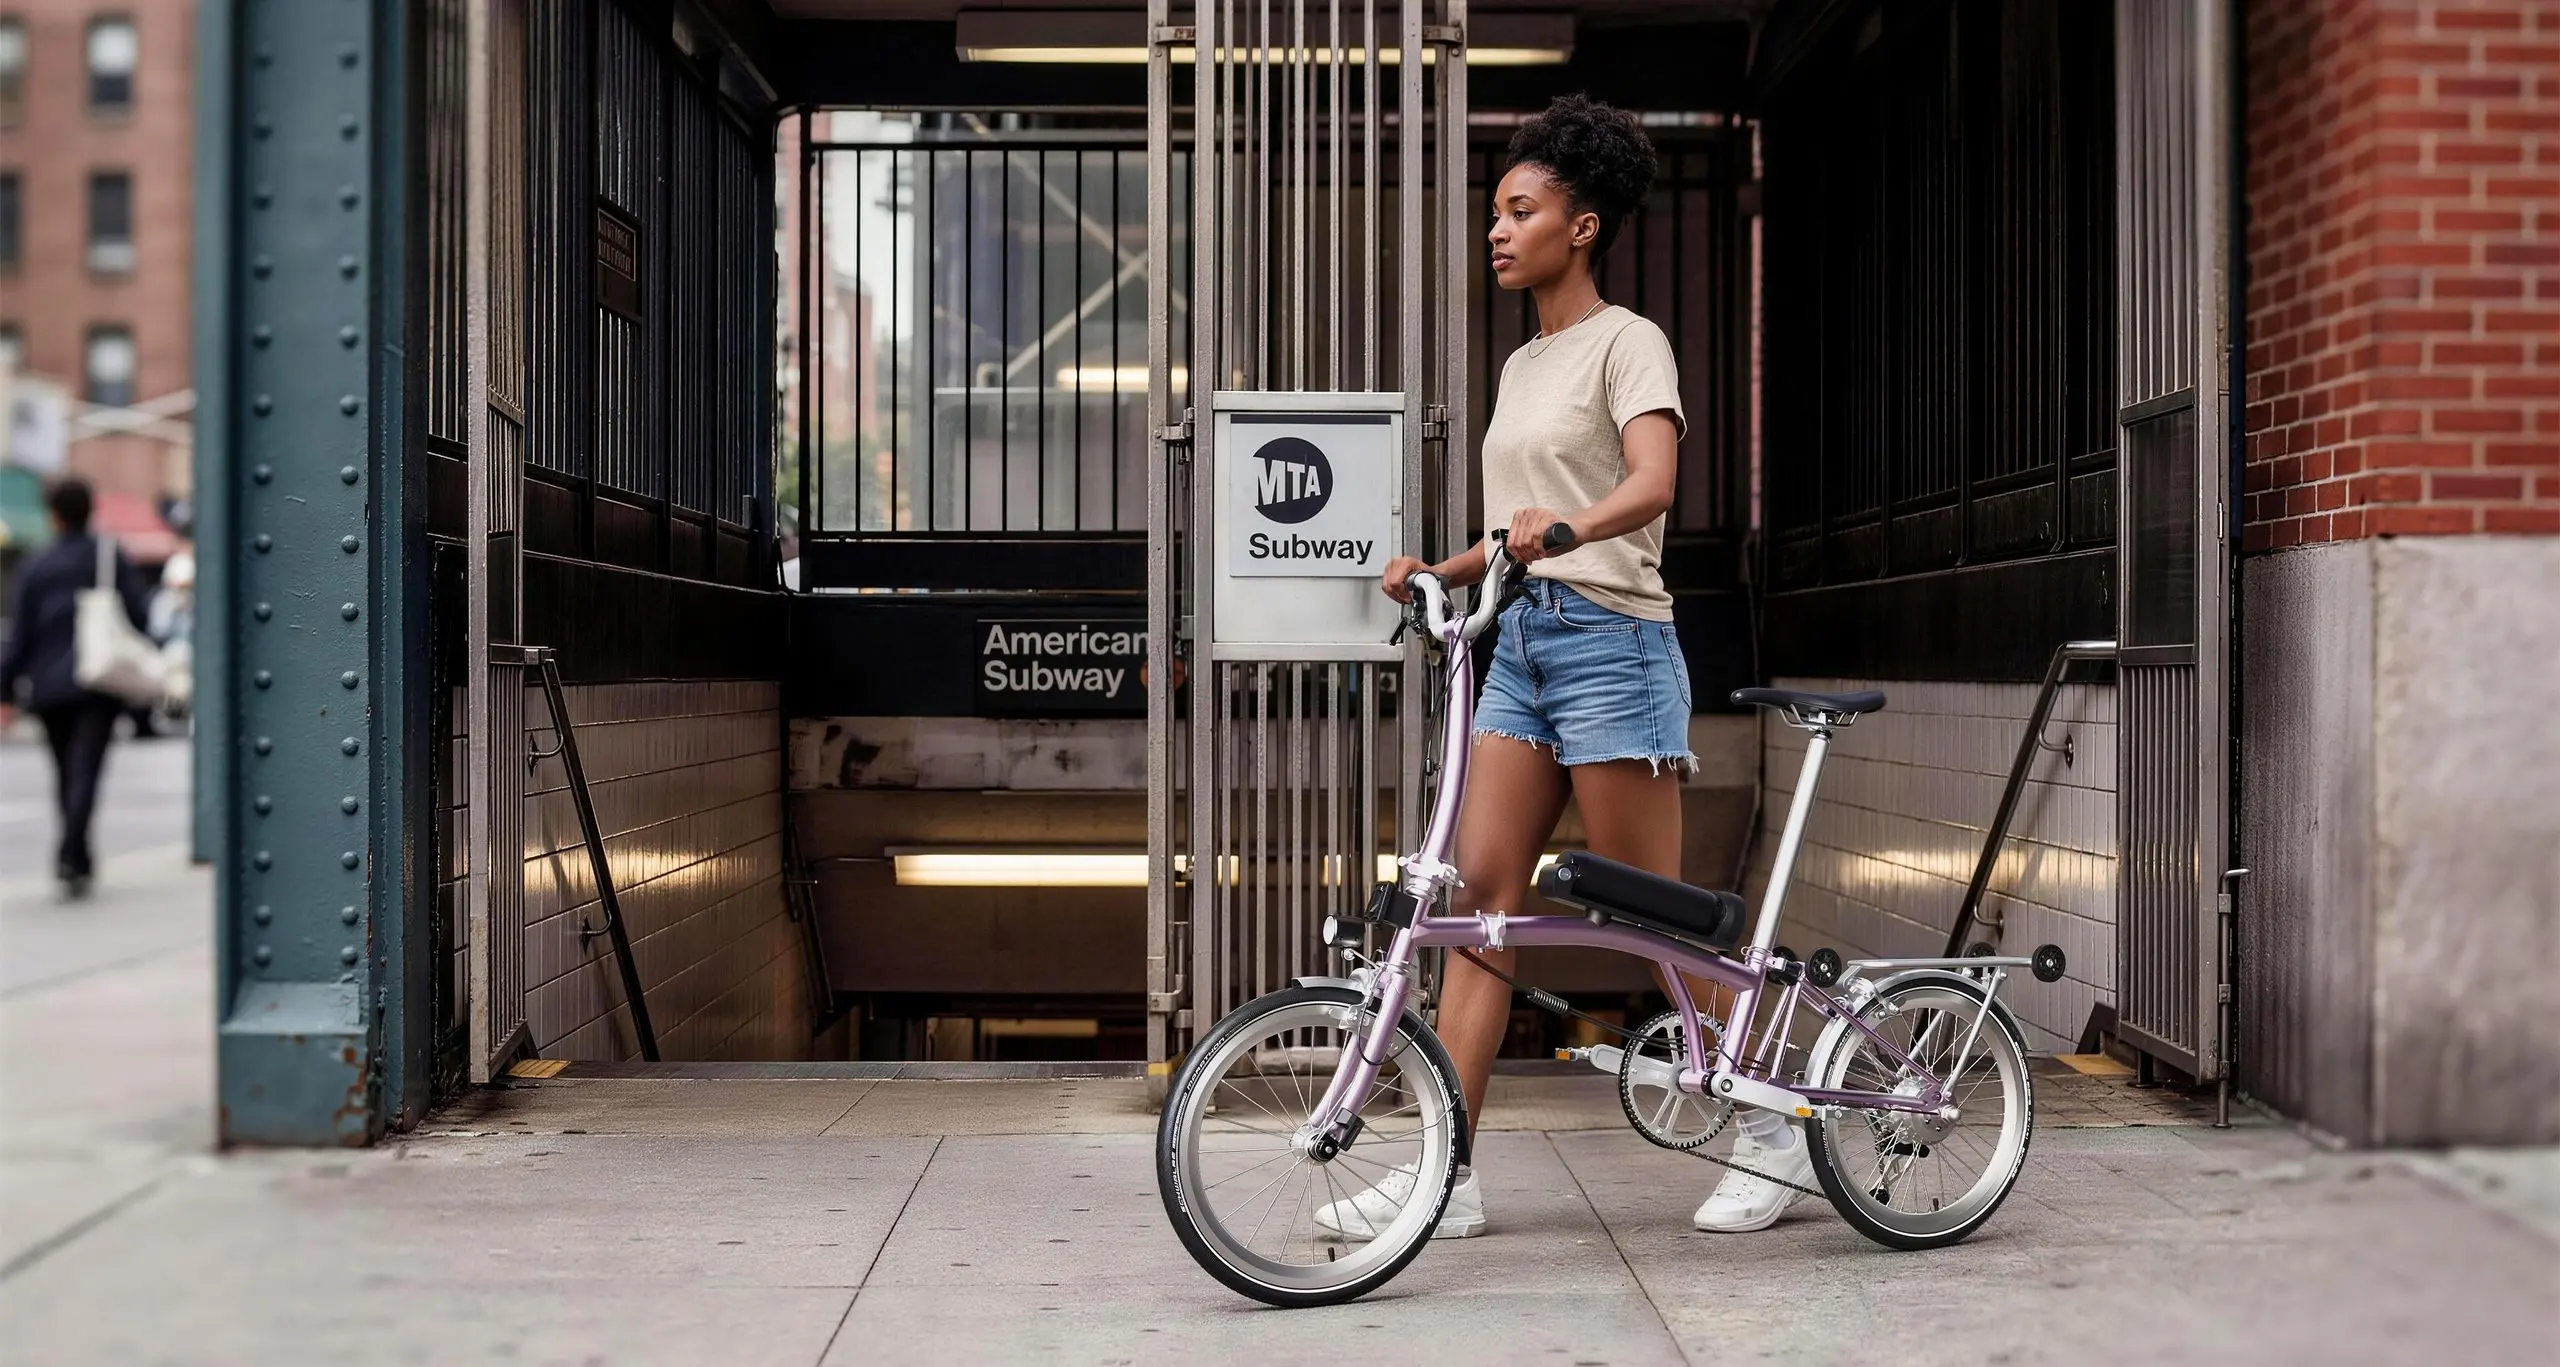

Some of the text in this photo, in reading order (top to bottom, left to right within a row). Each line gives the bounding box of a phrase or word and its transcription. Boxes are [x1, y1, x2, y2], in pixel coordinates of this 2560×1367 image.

[1253, 457, 1321, 506] MTA
[1249, 533, 1373, 565] Subway
[983, 624, 1149, 655] American
[983, 660, 1125, 698] Subway
